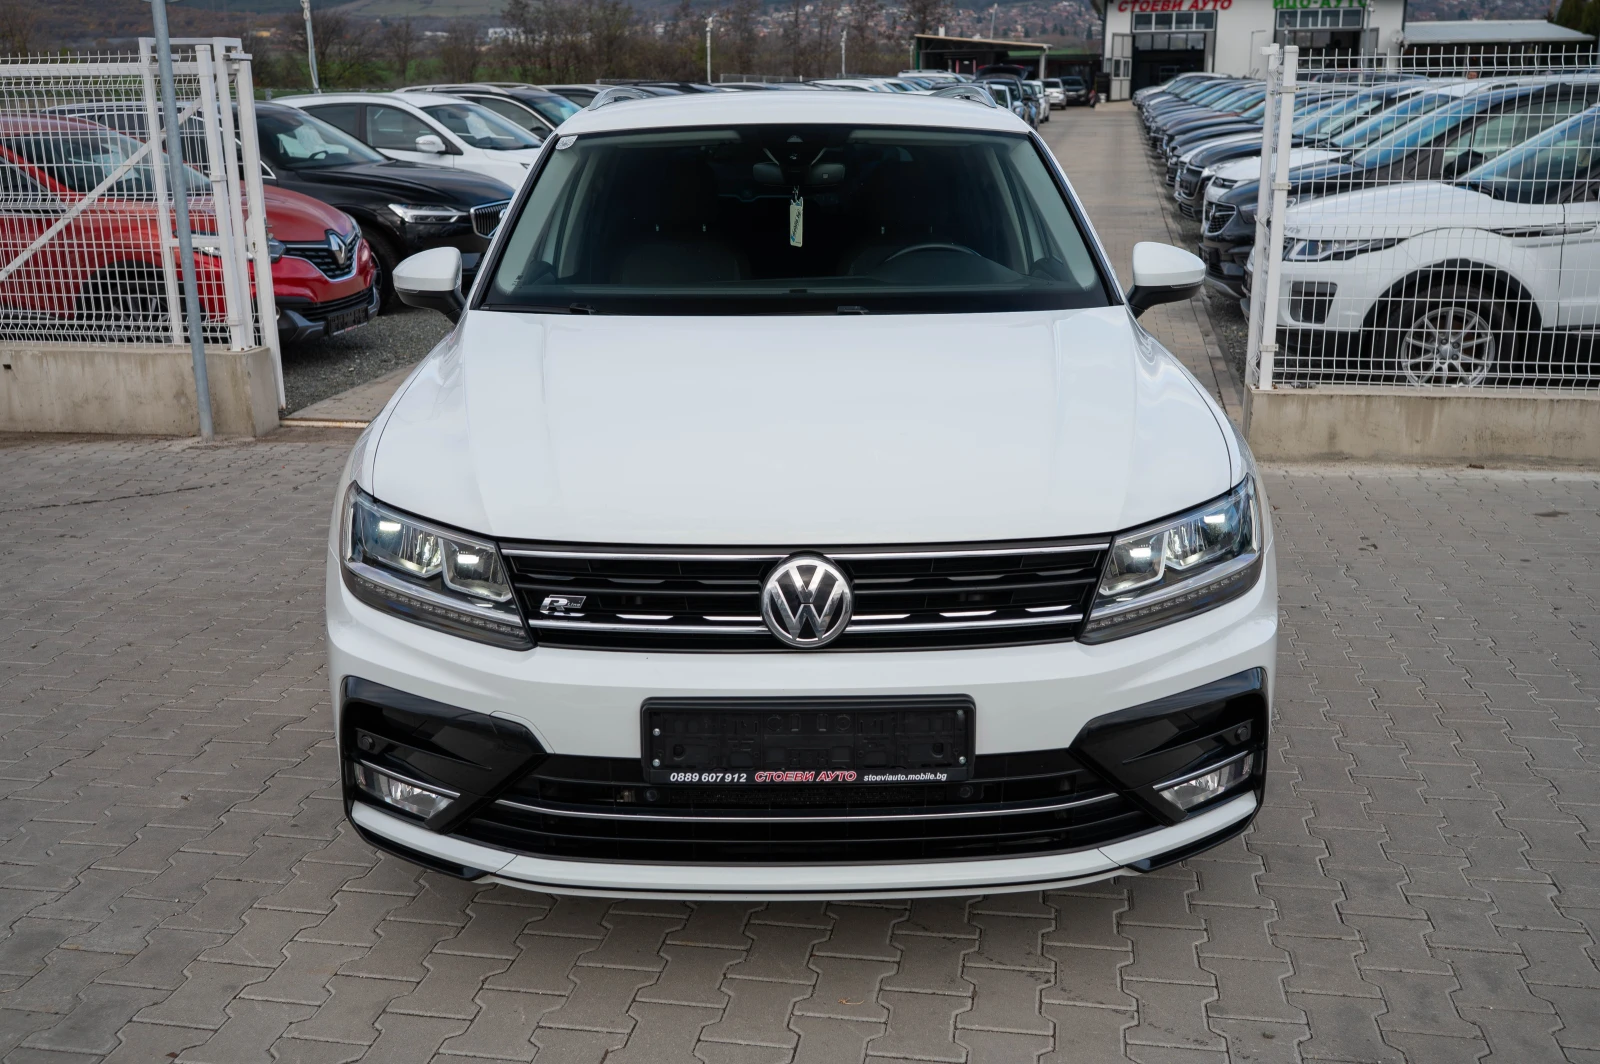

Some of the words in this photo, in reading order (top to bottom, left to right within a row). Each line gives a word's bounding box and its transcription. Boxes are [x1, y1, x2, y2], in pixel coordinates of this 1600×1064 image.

[1118, 0, 1183, 12] СТОЕВИ
[1188, 0, 1233, 10] АУТО
[670, 772, 699, 782] 0889
[701, 772, 723, 782] 607
[724, 772, 747, 782] 912
[755, 771, 815, 782] СТОЕВИ
[816, 770, 857, 782] АУТО
[863, 772, 947, 781] stoeviauto.mobile.bg
